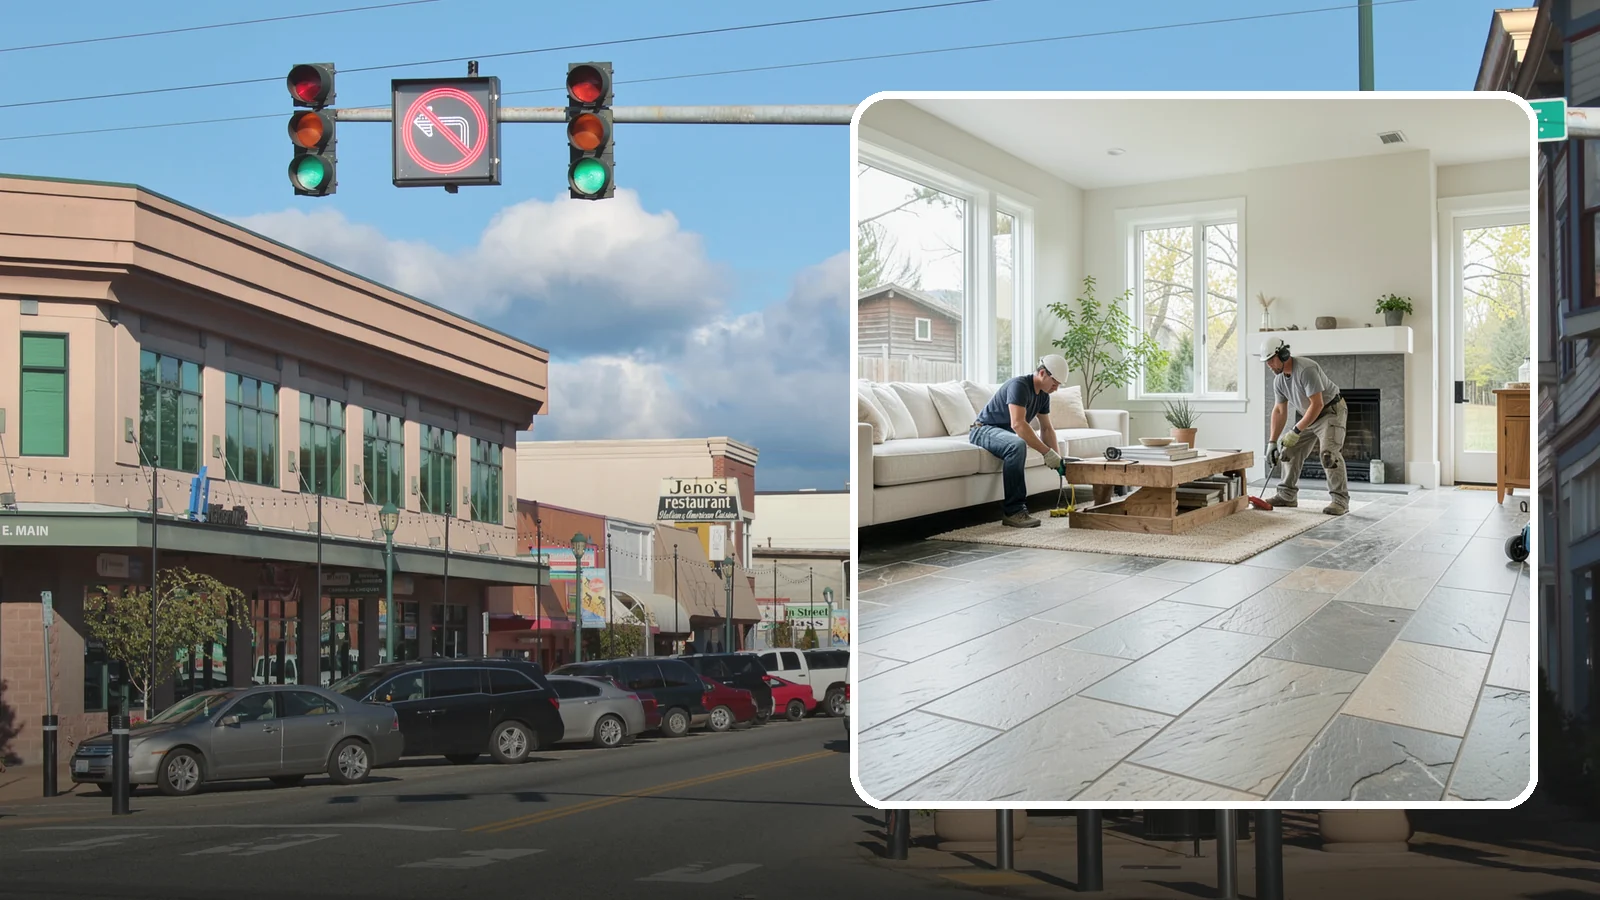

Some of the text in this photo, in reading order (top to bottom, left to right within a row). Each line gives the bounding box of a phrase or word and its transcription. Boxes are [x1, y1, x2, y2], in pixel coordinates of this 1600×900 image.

[669, 480, 727, 495] Jeno's
[665, 496, 731, 509] restaurant
[658, 509, 682, 520] Italian
[686, 509, 715, 520] American
[715, 509, 737, 519] Cuisine
[2, 525, 49, 537] E. MAIN
[797, 607, 828, 617] Street
